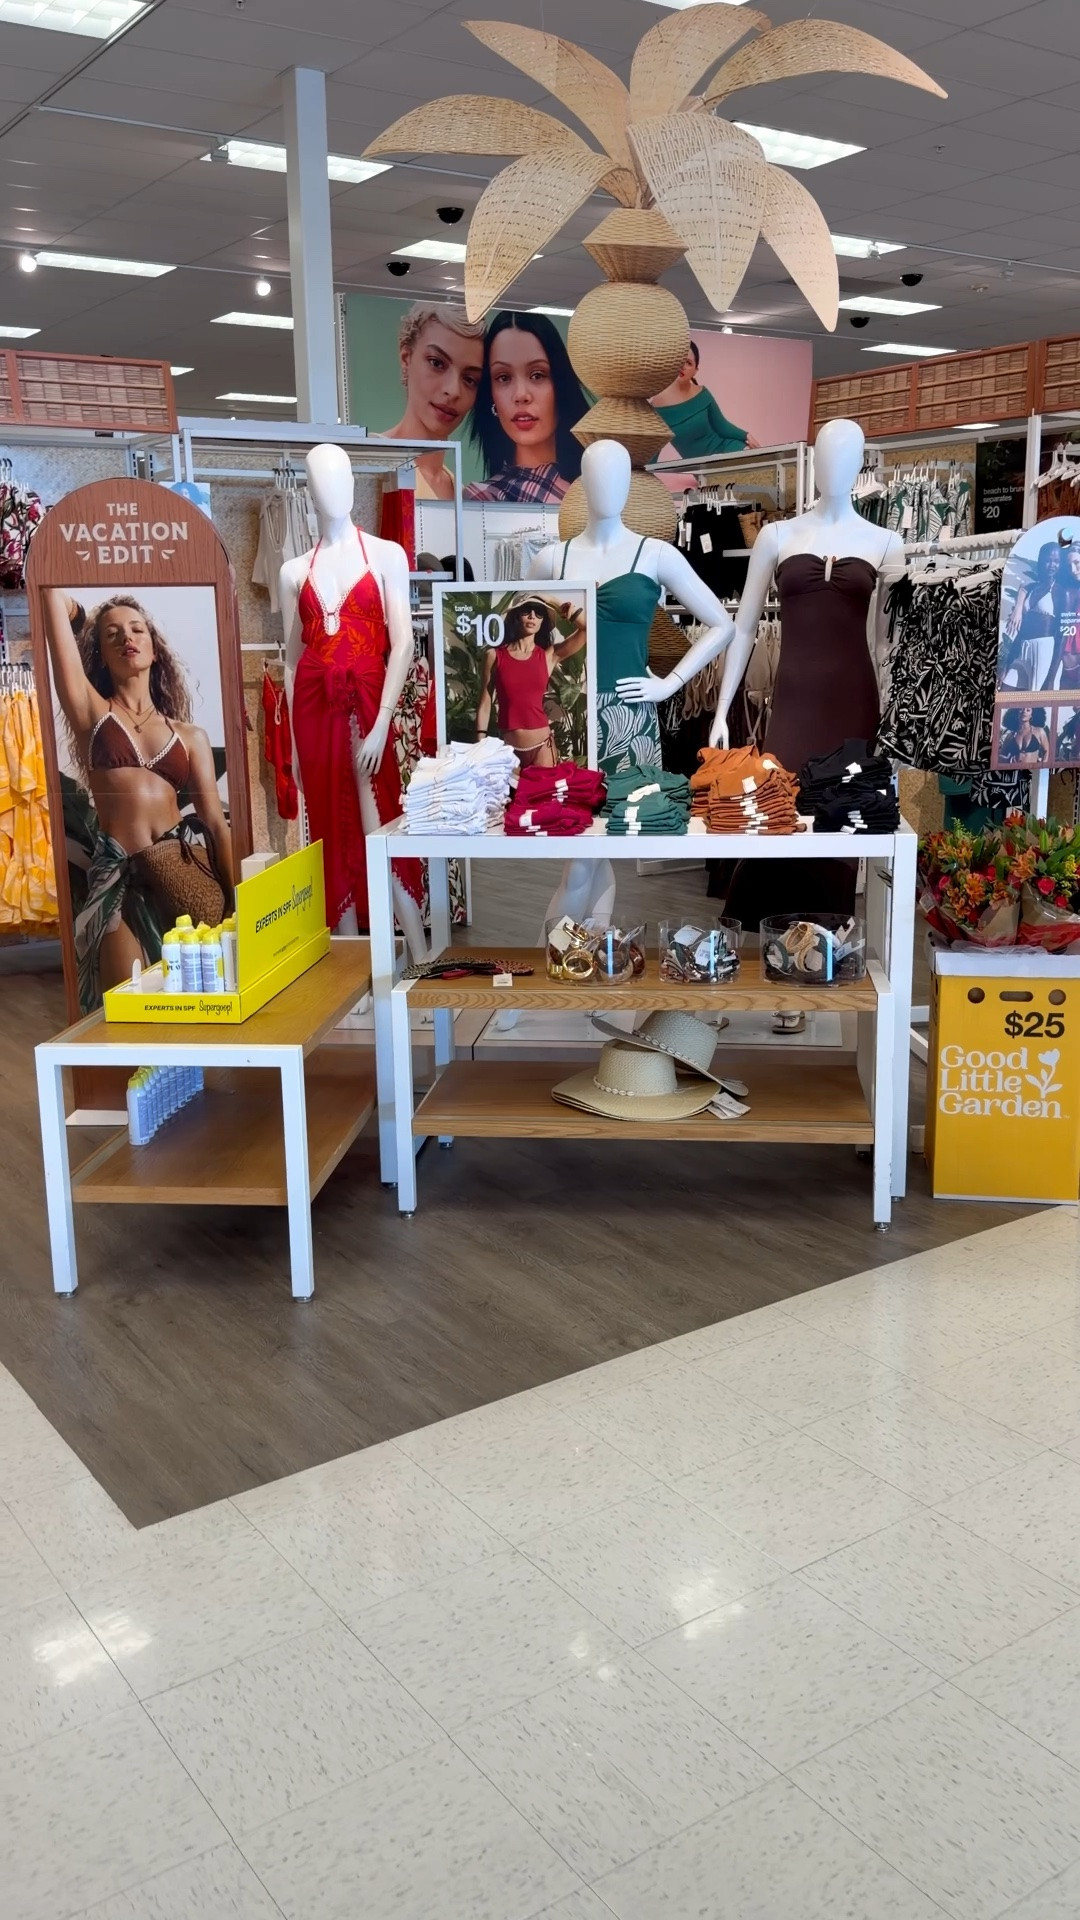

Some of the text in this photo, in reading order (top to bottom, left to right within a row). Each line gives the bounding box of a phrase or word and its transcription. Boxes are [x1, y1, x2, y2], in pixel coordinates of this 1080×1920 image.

[983, 487, 1001, 495] beach
[1009, 485, 1024, 493] brun
[983, 495, 1012, 504] separates
[106, 503, 138, 516] THE
[982, 505, 1000, 519] $20
[59, 521, 188, 542] VACATION
[98, 545, 154, 564] EDIT
[456, 612, 505, 647] $10
[1059, 625, 1077, 637] $20
[255, 910, 277, 934] EXPERTS
[277, 906, 284, 919] IN
[283, 900, 292, 915] SPF
[1004, 1010, 1065, 1039] $25
[940, 1045, 1028, 1070] Good
[940, 1068, 1022, 1093] Little
[938, 1092, 1062, 1119] Garden
